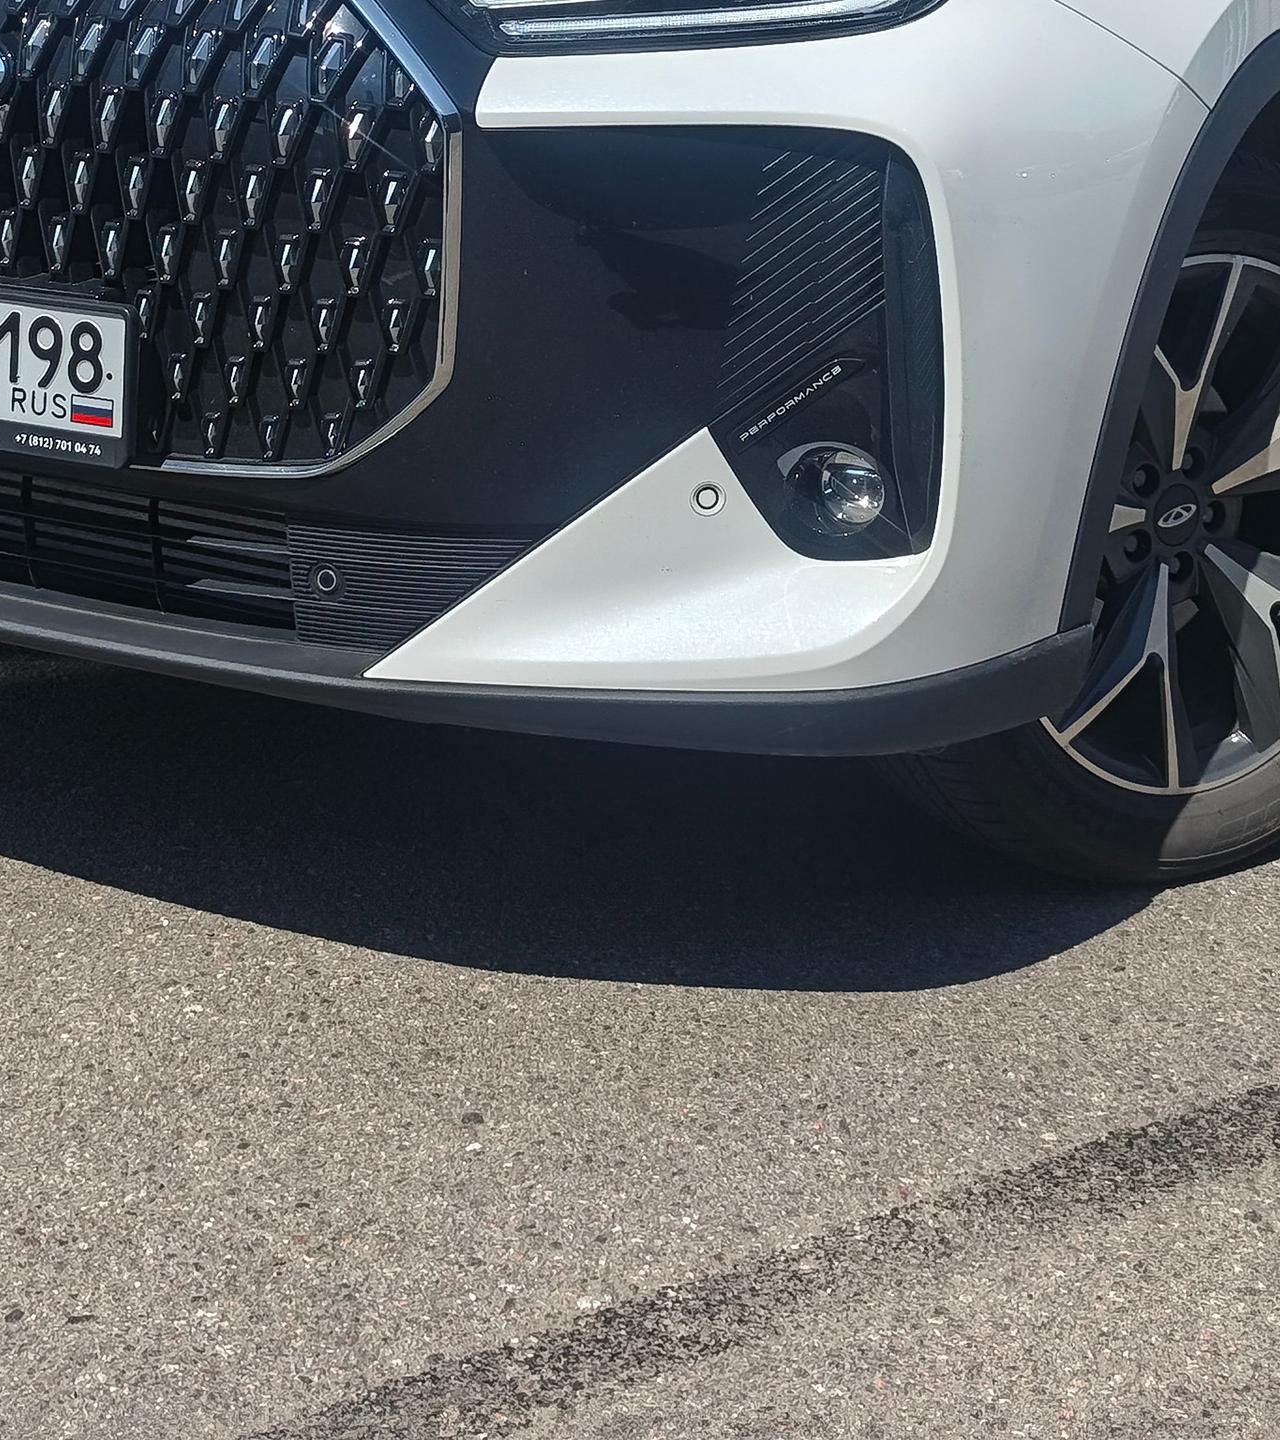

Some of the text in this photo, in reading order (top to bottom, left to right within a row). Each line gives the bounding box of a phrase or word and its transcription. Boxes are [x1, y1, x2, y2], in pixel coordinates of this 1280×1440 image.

[11, 386, 67, 419] RUS
[739, 365, 842, 442] PERFORMANCE
[14, 433, 102, 456] +7 (812) 701 04 74
